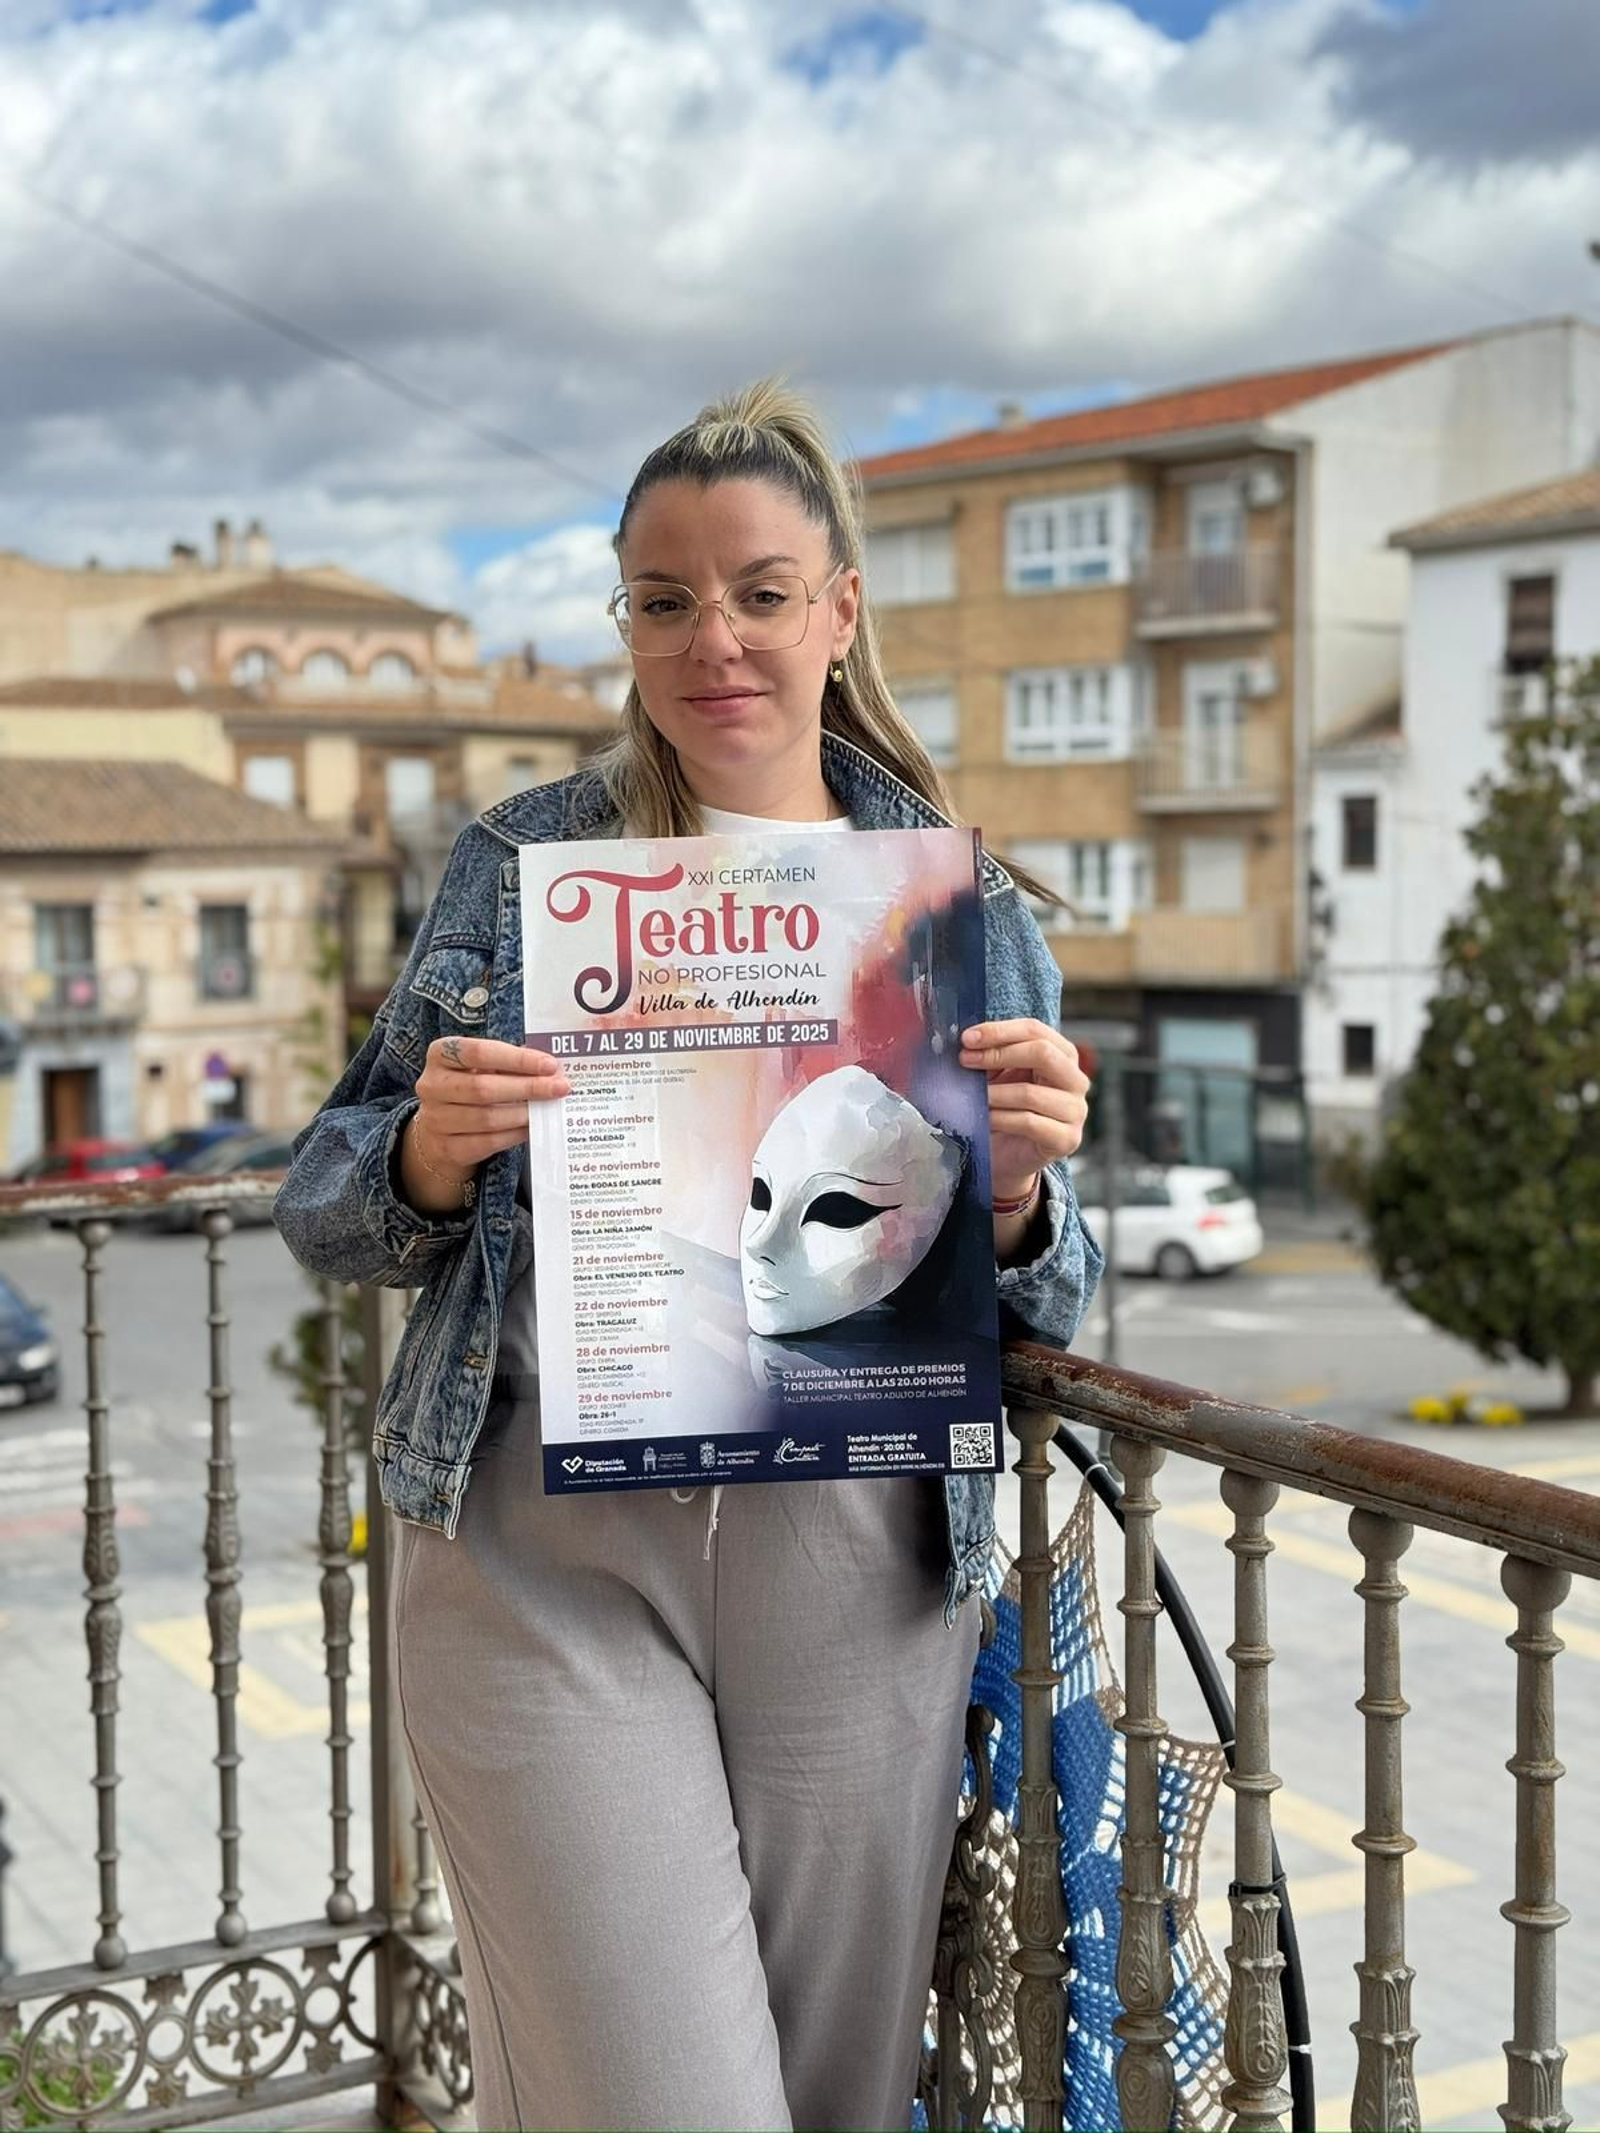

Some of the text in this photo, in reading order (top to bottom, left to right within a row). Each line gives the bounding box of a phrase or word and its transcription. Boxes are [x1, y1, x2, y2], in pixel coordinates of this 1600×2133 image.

[688, 867, 815, 886] XXI CERTAMEN
[547, 863, 820, 1014] Teatro
[638, 963, 827, 984] NO PROFESIONAL
[640, 988, 820, 1015] Villa de Alhendín
[552, 1024, 828, 1054] DEL 7 AL 29 DE NOVIEMBRE DE 2025
[573, 1063, 588, 1071] de
[591, 1060, 651, 1071] noviembre
[566, 1115, 654, 1127] 8 de noviembre
[568, 1160, 660, 1173] 14 de noviembre
[631, 1178, 661, 1187] SANGRE
[571, 1206, 662, 1219] 15 de noviembre
[604, 1226, 623, 1234] NIÑA
[573, 1253, 664, 1265] 21 de noviembre
[655, 1269, 684, 1277] TEATRO
[575, 1298, 668, 1311] 22 de noviembre
[576, 1344, 670, 1357] 28 de noviembre
[783, 1364, 966, 1379] CLAUSURA Y ENTREGA DE PREMIOS
[783, 1376, 966, 1391] 7 DE DICIEMBRE A LAS 20.00 HORAS
[578, 1390, 672, 1403] 29 de noviembre
[784, 1388, 967, 1403] TALLER MUNICIPAL TEATRO ADULTO DE ALHENDÍN
[847, 1433, 917, 1443] Teatro Municipal de
[849, 1444, 880, 1452] Alhendín
[585, 1458, 624, 1467] Diputación
[849, 1453, 926, 1463] ENTRADA GRATUITA
